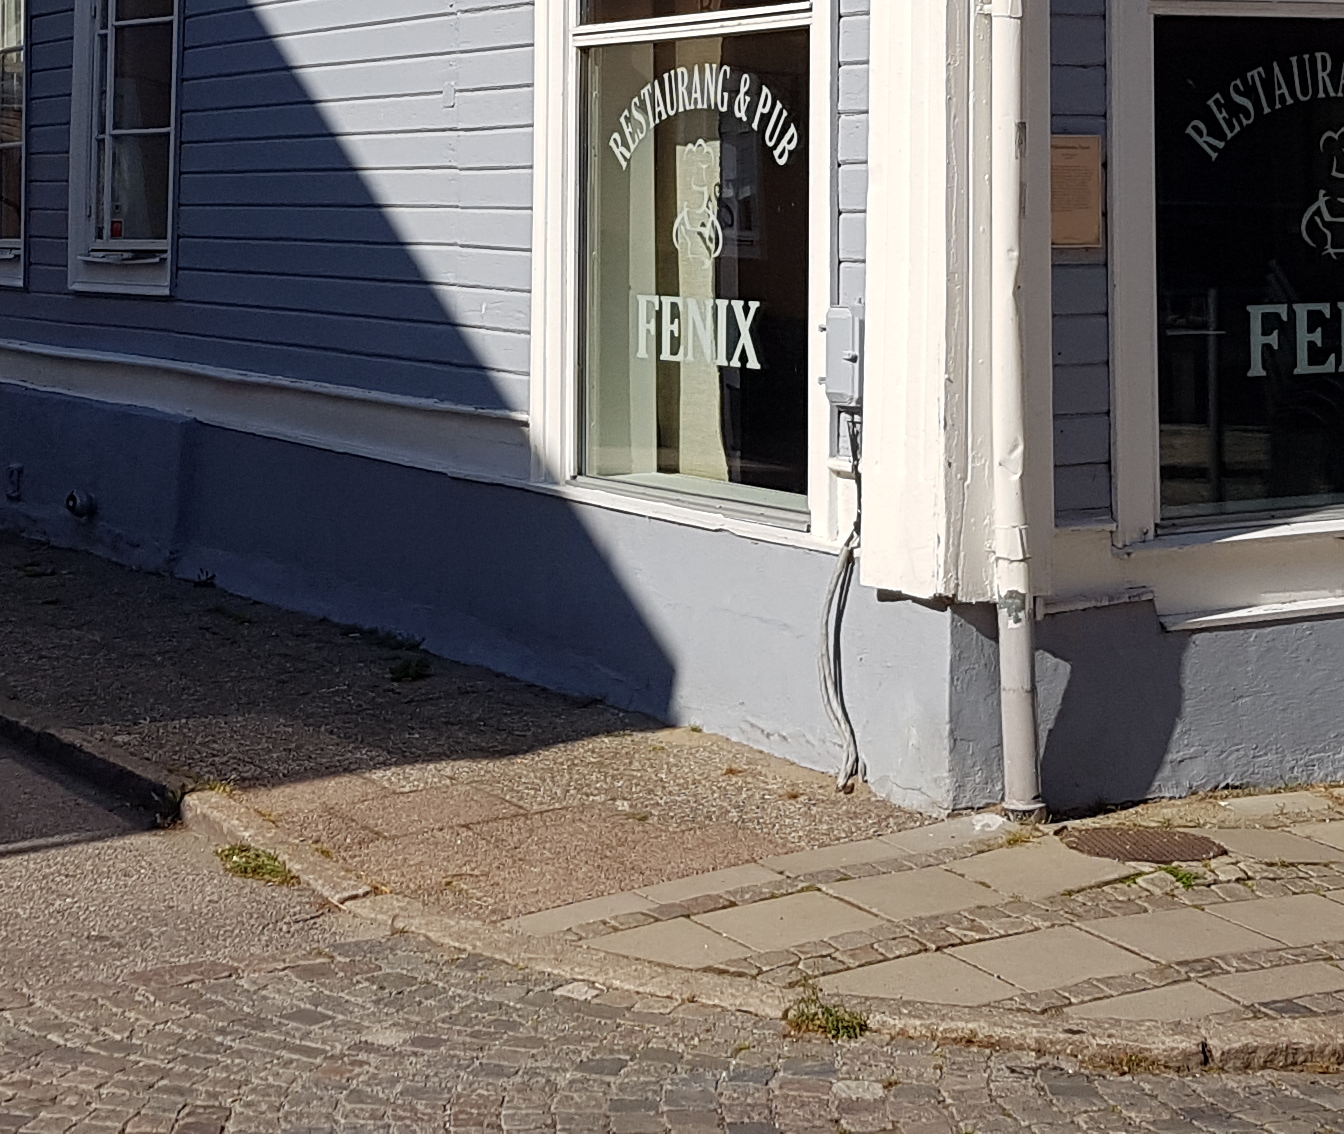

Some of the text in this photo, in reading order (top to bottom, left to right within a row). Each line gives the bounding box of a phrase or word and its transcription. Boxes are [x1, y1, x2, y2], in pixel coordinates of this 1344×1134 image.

[609, 63, 798, 171] RESTAURANG & PUB
[636, 294, 761, 370] FENIX
